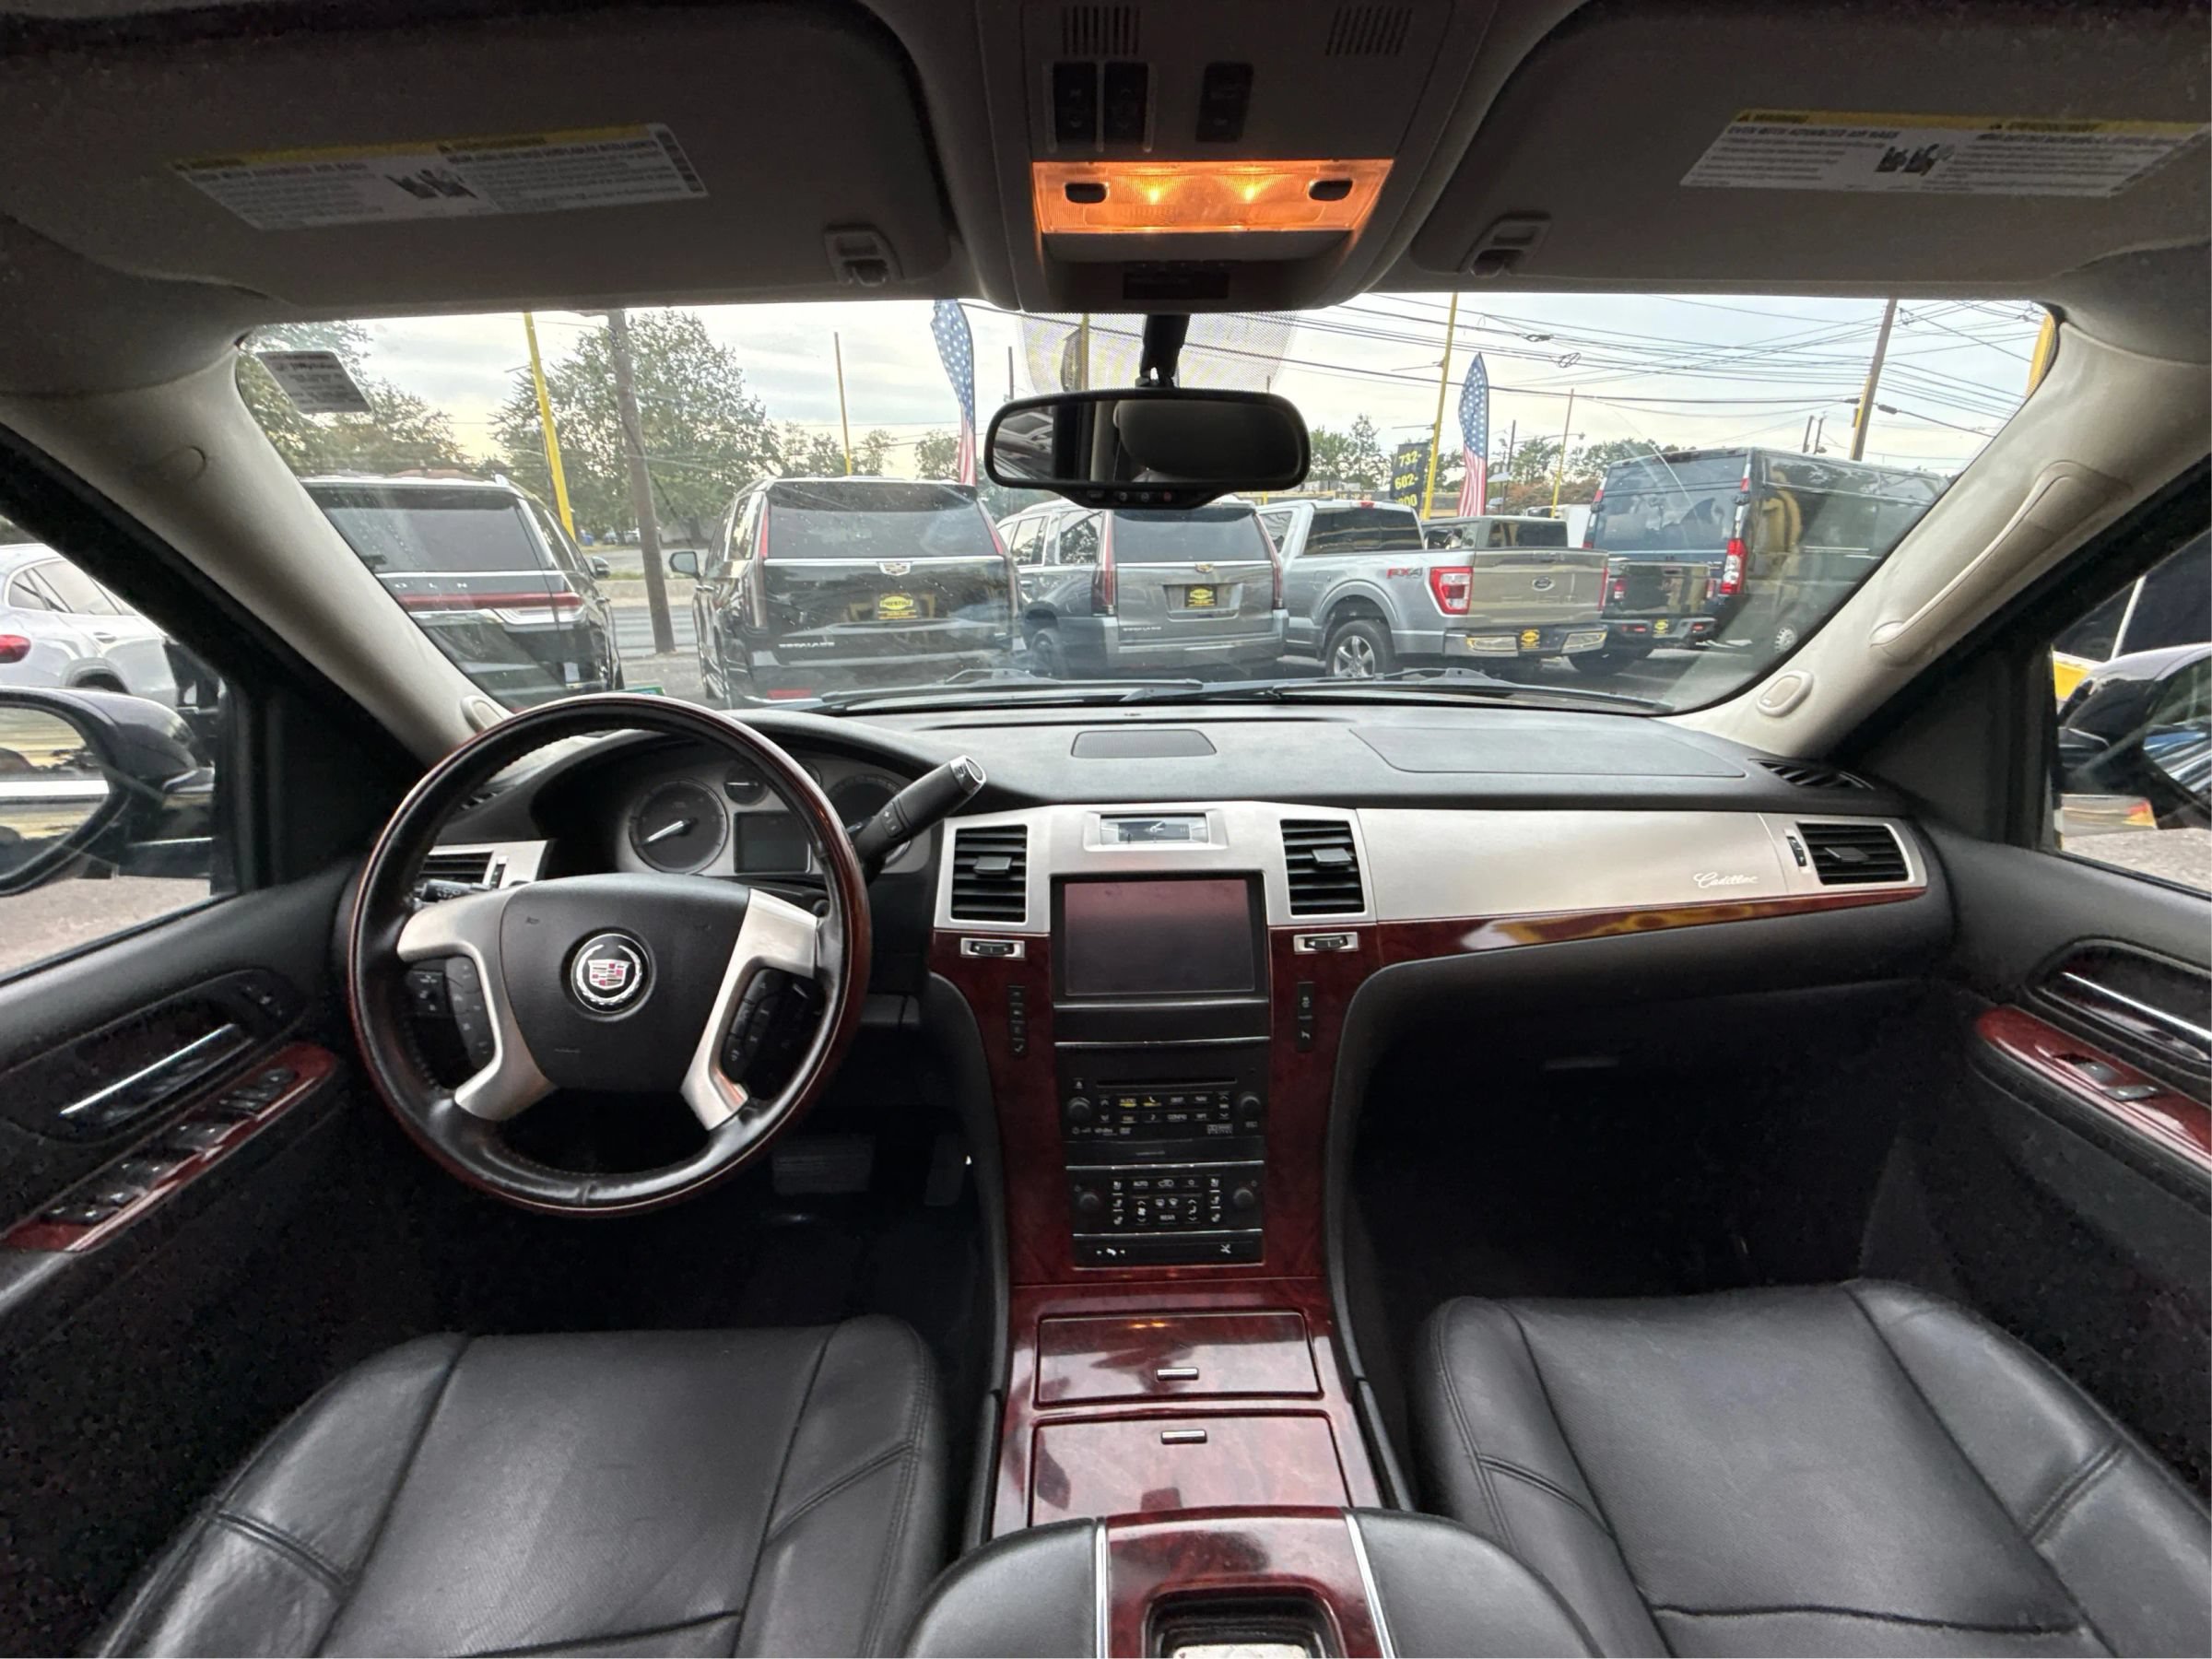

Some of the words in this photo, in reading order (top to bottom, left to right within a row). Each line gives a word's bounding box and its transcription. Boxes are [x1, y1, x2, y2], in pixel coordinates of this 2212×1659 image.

[1399, 451, 1422, 467] 732-
[1394, 474, 1418, 490] 602-
[1693, 872, 1759, 888] Cadillac
